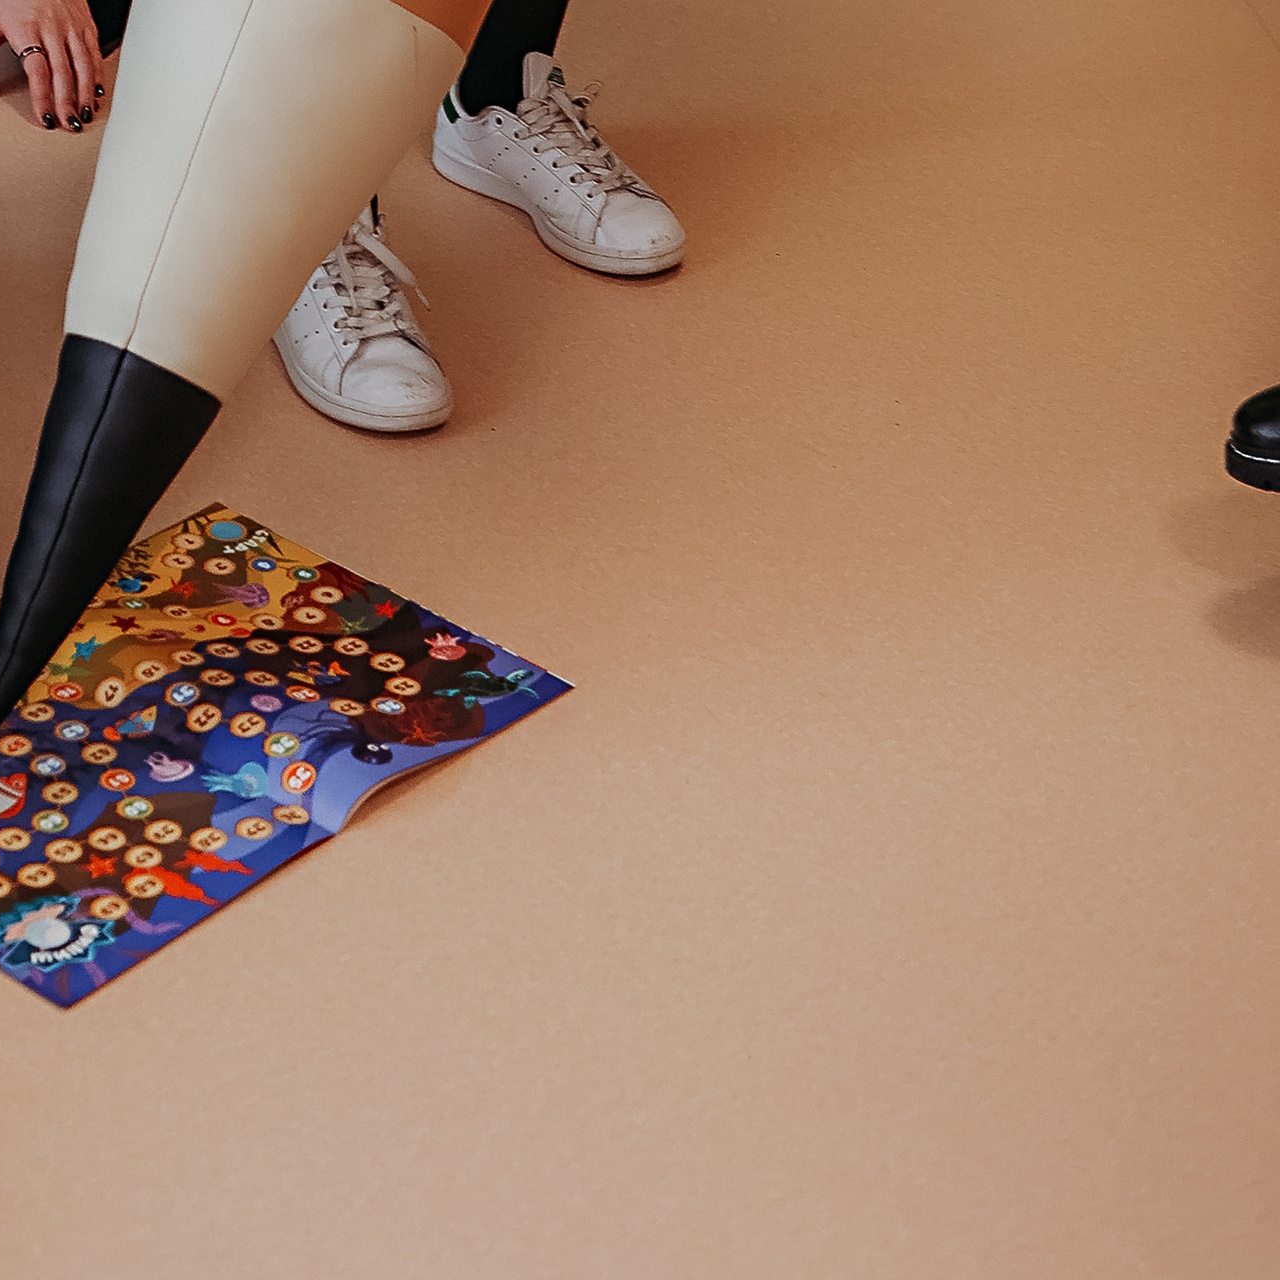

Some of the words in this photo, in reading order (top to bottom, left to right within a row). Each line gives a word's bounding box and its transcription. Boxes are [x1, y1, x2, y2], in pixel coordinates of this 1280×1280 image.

[223, 529, 269, 554] СТАРТ
[126, 600, 142, 609] 11
[170, 608, 187, 616] 10
[255, 642, 274, 652] 21
[296, 640, 316, 649] 22
[341, 641, 362, 652] 23
[214, 646, 236, 655] 20
[180, 654, 195, 663] 19
[378, 658, 398, 668] 24
[142, 665, 160, 678] 18
[207, 673, 229, 682] 30
[253, 674, 272, 683] 29
[394, 681, 414, 691] 25
[105, 685, 119, 702] 17
[172, 685, 195, 702] 31
[340, 703, 358, 712] 27
[194, 709, 215, 727] 32
[238, 717, 260, 733] 33
[247, 822, 266, 836] 37
[30, 924, 99, 965] ФИНИШ
